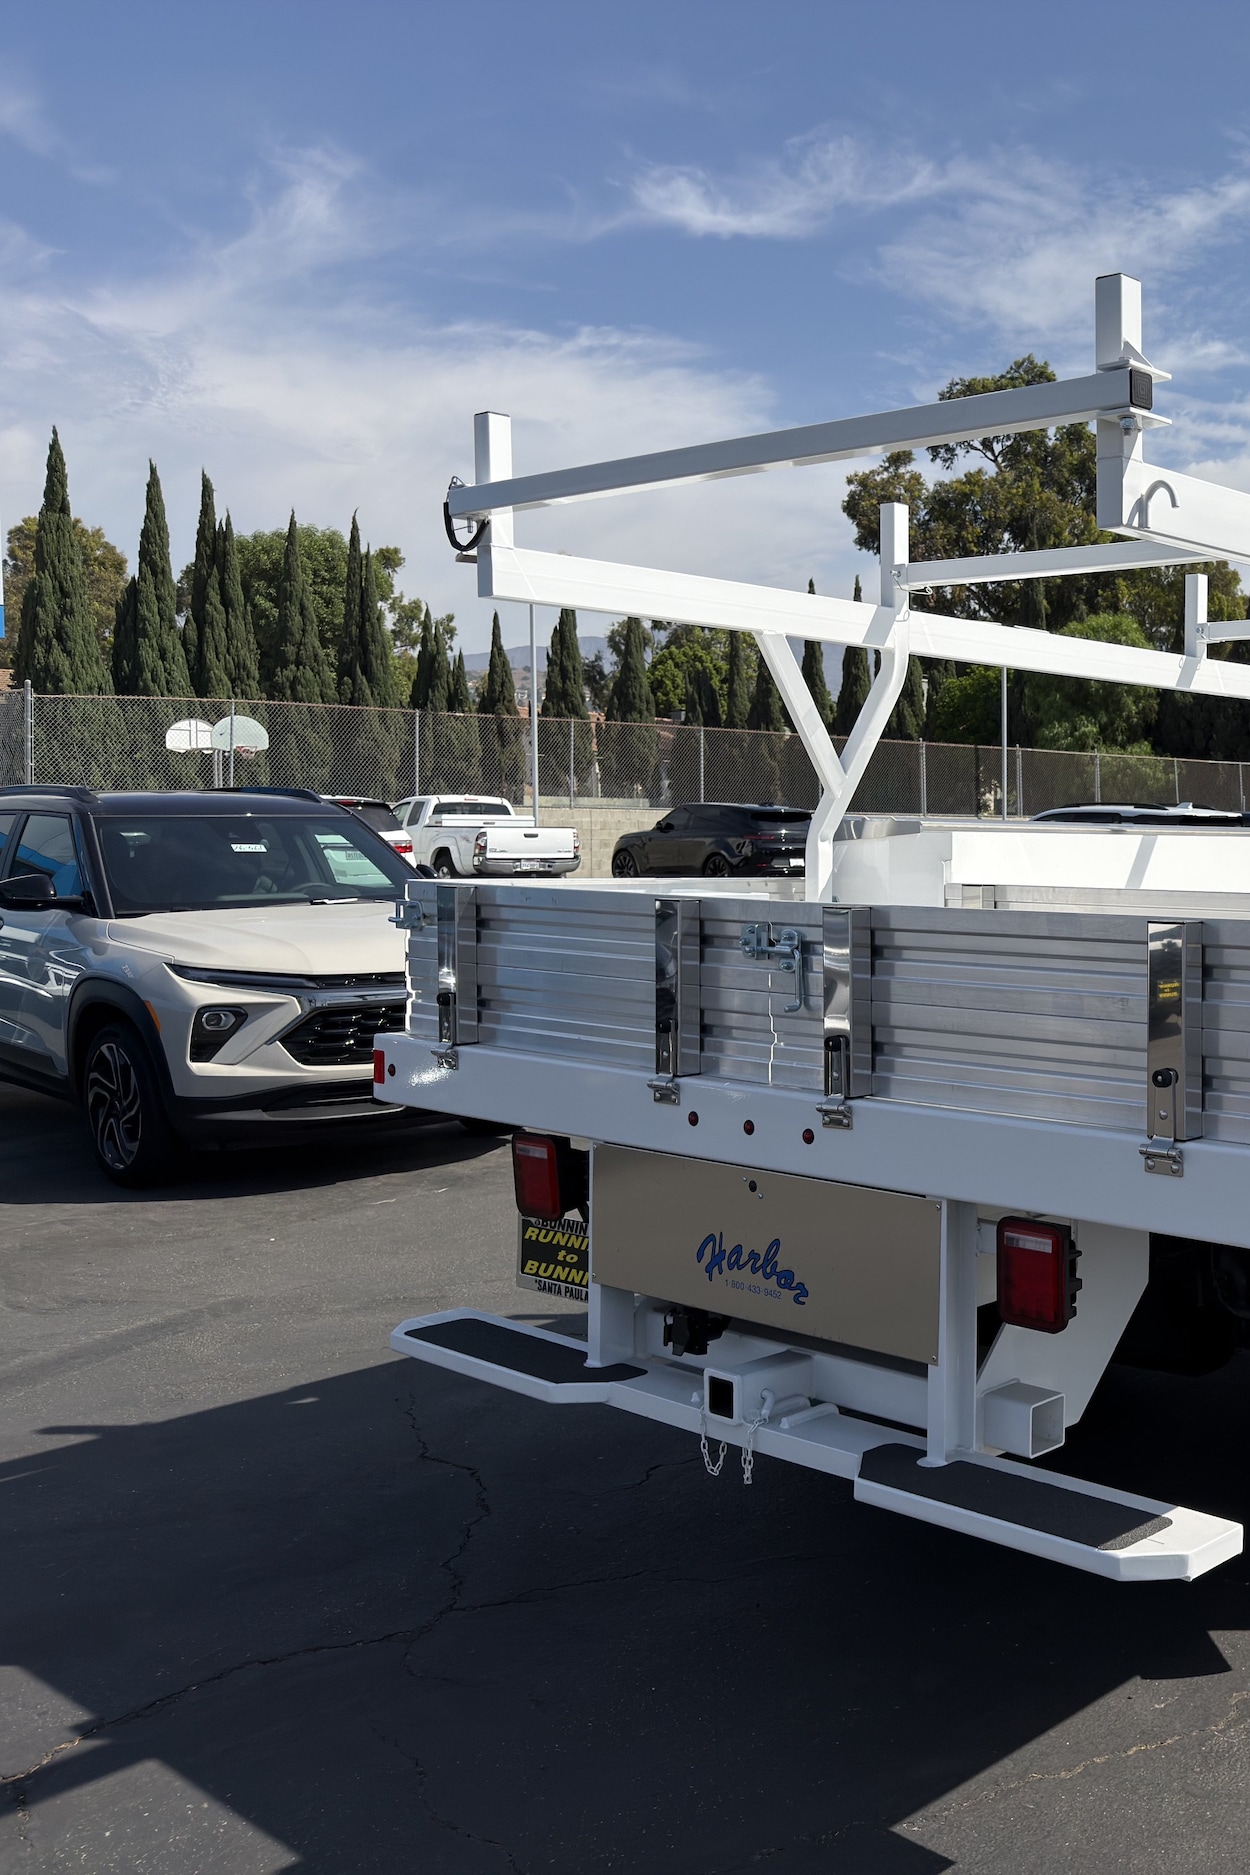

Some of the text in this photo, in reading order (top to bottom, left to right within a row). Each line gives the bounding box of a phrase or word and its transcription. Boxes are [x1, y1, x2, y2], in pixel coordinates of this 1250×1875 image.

[524, 1226, 589, 1252] RUNNI
[557, 1250, 579, 1263] to
[696, 1231, 809, 1305] Harbor
[564, 1286, 589, 1303] PAULA
